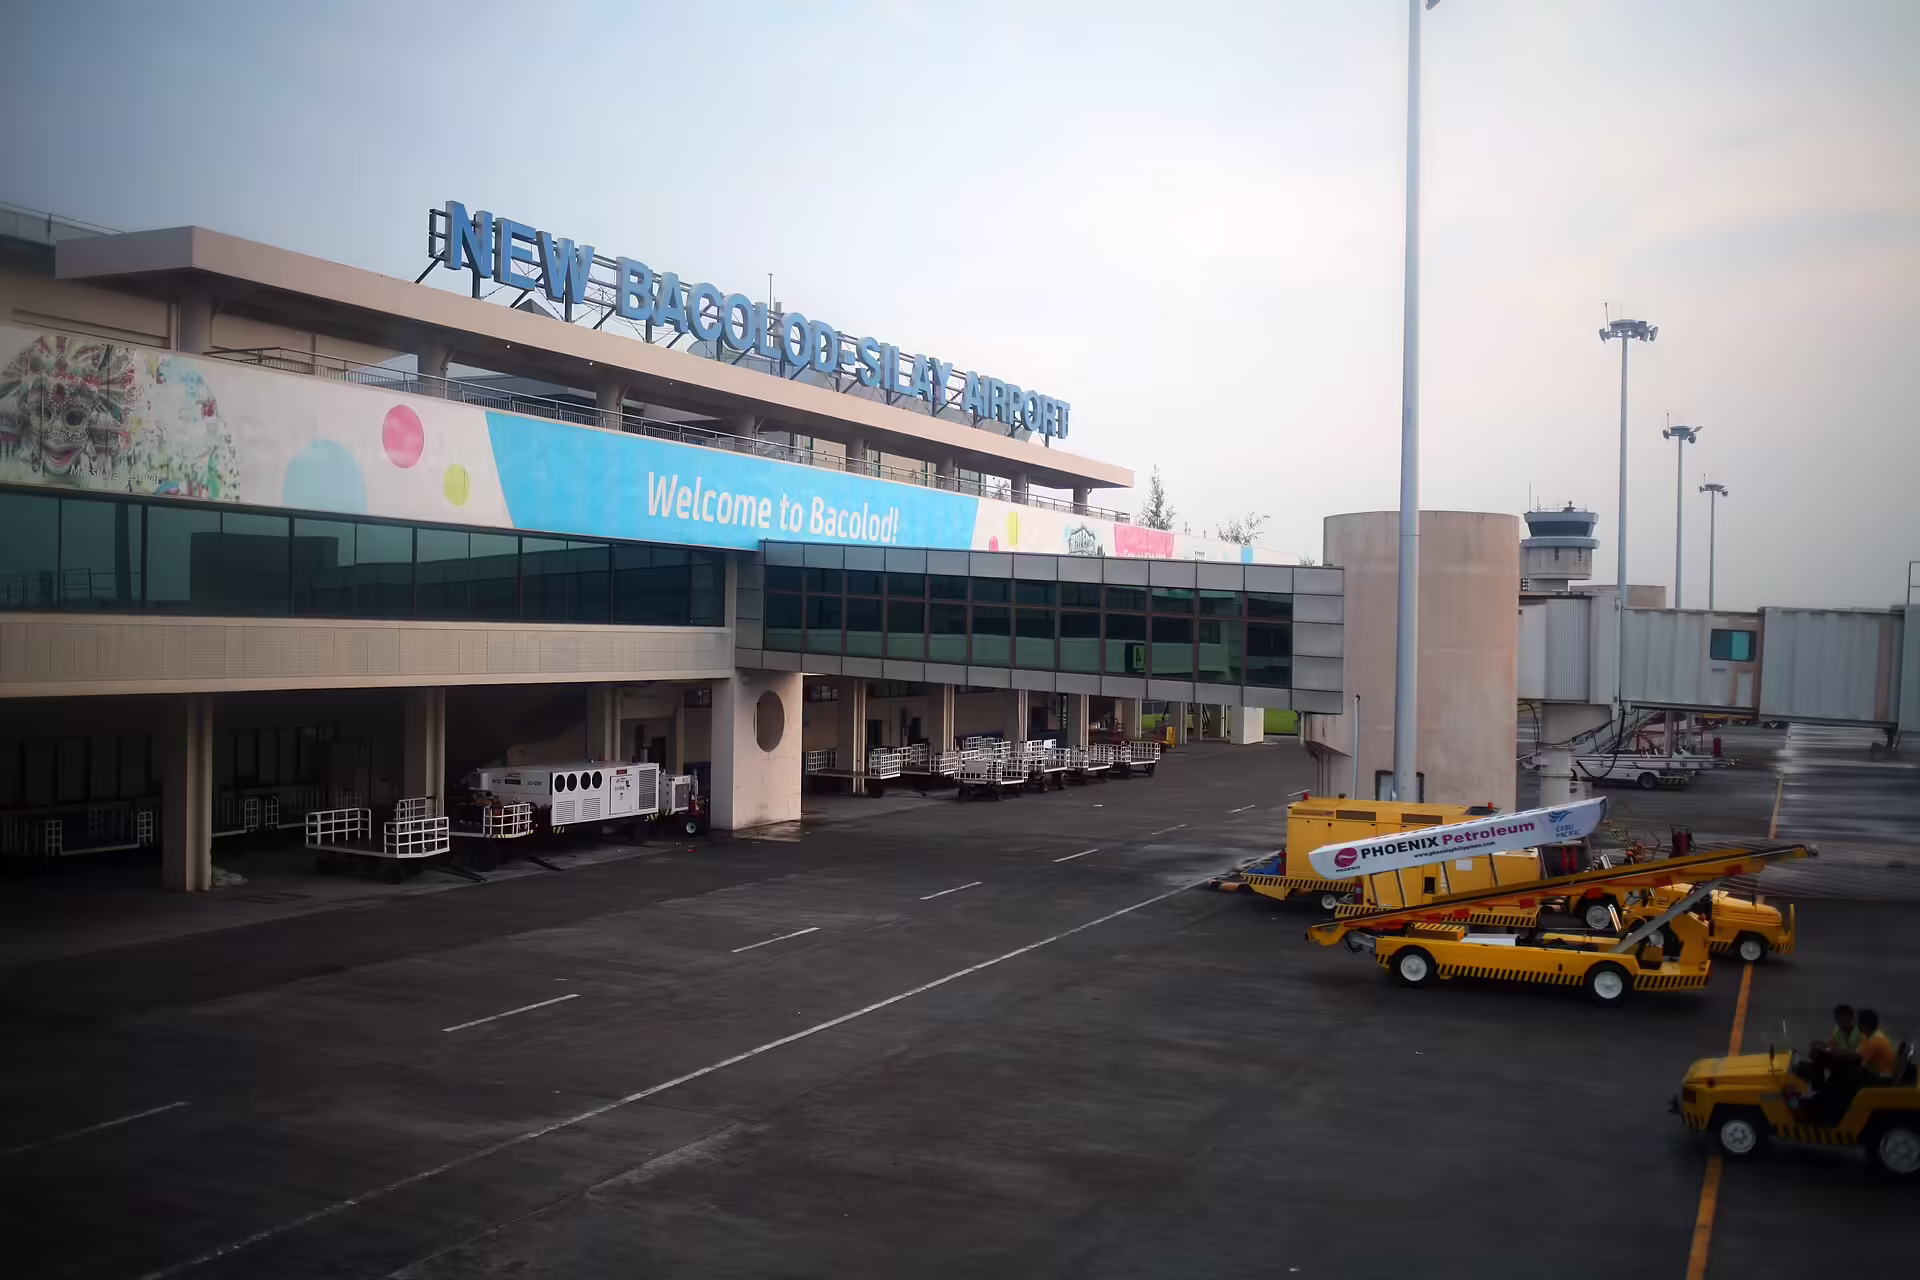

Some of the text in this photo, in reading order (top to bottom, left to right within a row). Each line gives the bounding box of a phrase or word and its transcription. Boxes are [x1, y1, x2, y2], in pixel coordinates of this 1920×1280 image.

[445, 200, 1070, 440] NEW BACOLOD-SILAY AIRPORT
[648, 471, 899, 544] Welcome to Bacolod!
[1361, 822, 1536, 860] PHOENIX Petroleum
[1556, 824, 1574, 832] CEBU
[1413, 841, 1496, 859] www.phoenixphilippines.com
[1335, 865, 1361, 873] PHOENIX
